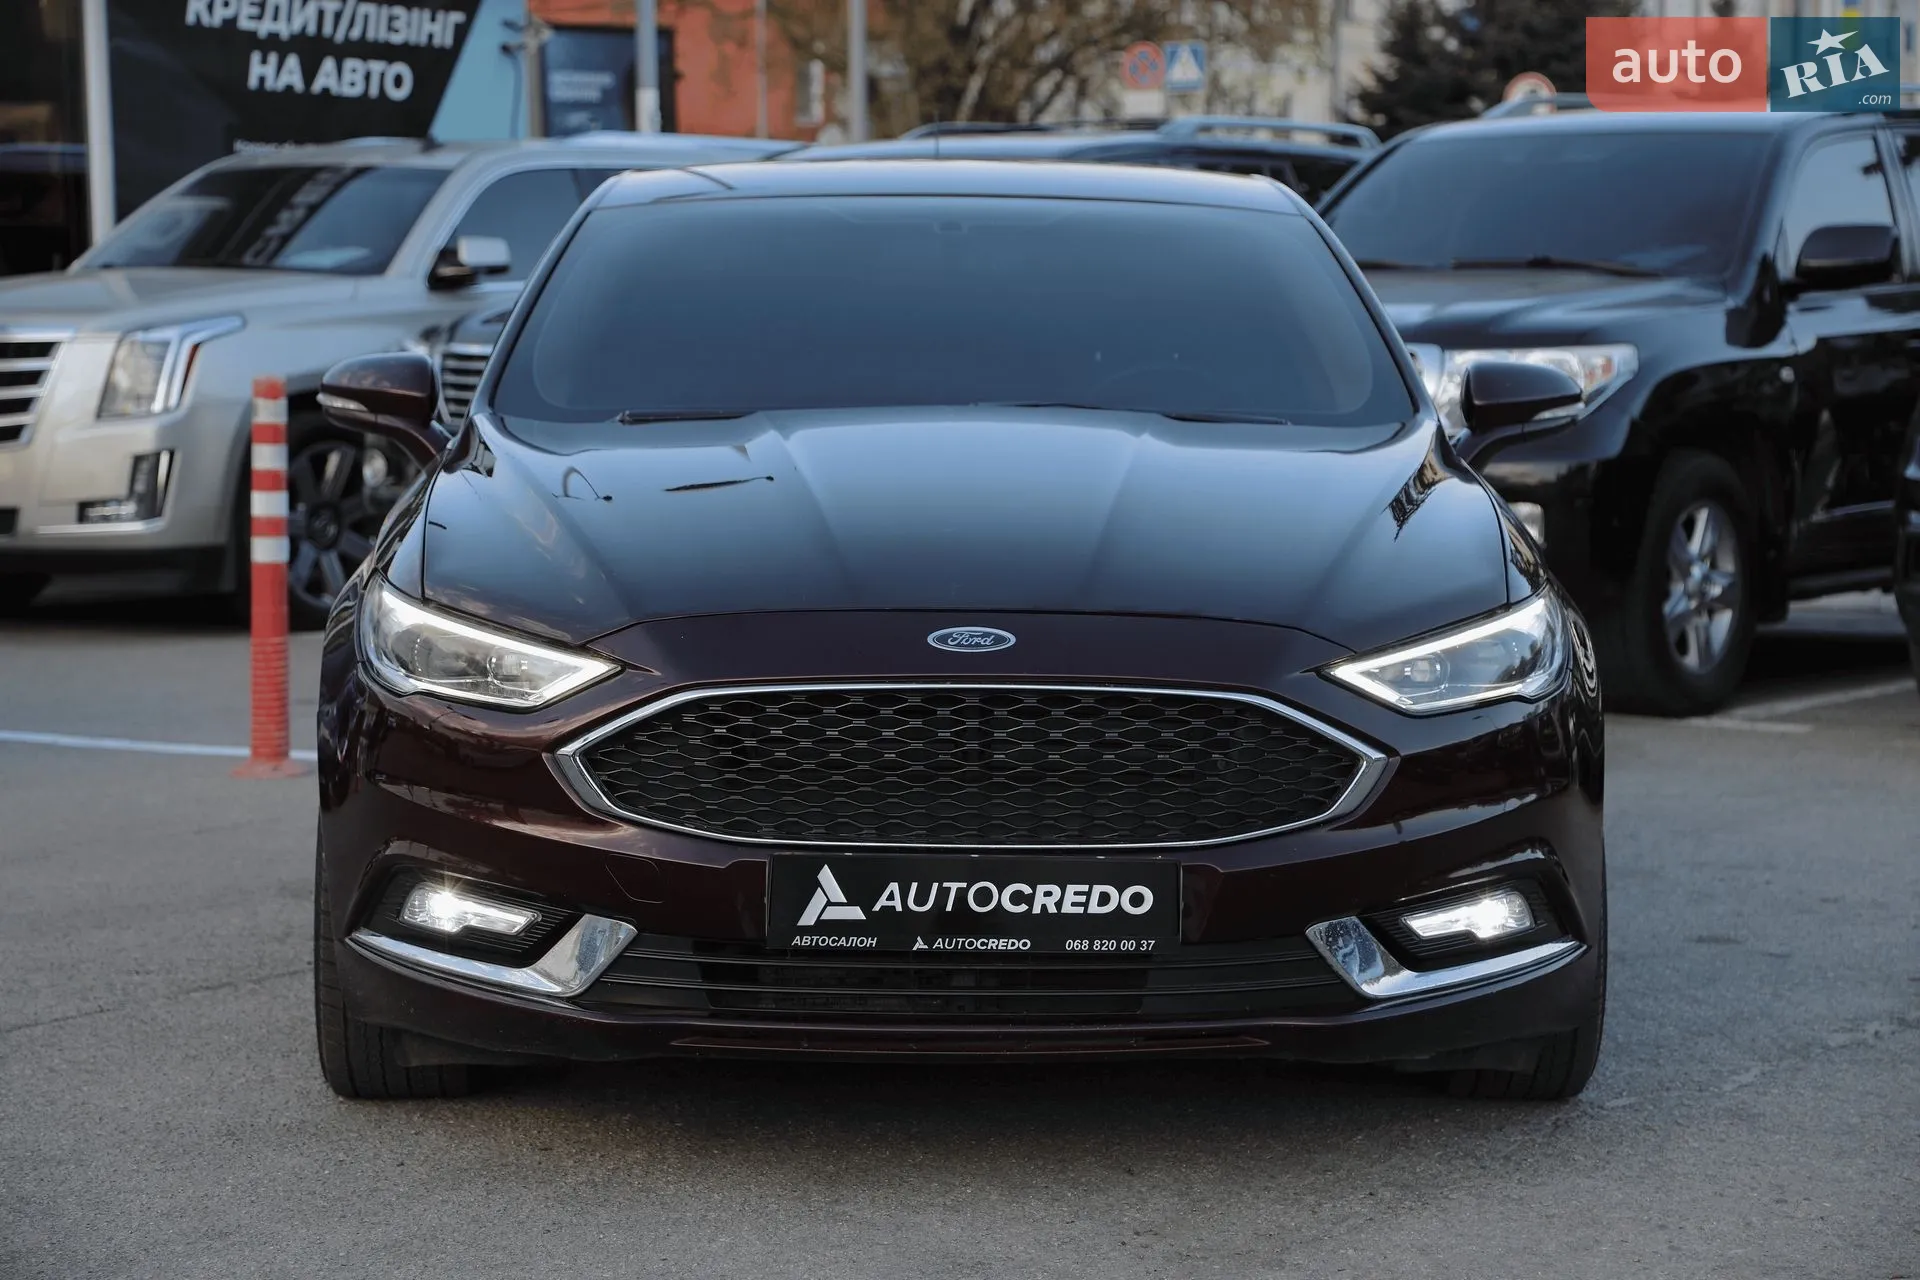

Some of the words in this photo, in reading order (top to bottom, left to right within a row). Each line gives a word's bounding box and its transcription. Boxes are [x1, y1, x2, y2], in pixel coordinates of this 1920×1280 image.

[247, 49, 305, 93] НА
[310, 55, 414, 101] АВТО
[947, 631, 995, 646] Ford
[872, 881, 1154, 915] AUTOCREDO
[791, 935, 877, 948] АВТОСАЛОН
[932, 937, 1031, 951] AUTOCREDO
[1065, 939, 1089, 951] 068
[1093, 939, 1116, 951] 820
[1120, 939, 1136, 951] 00
[1139, 939, 1155, 951] 37
